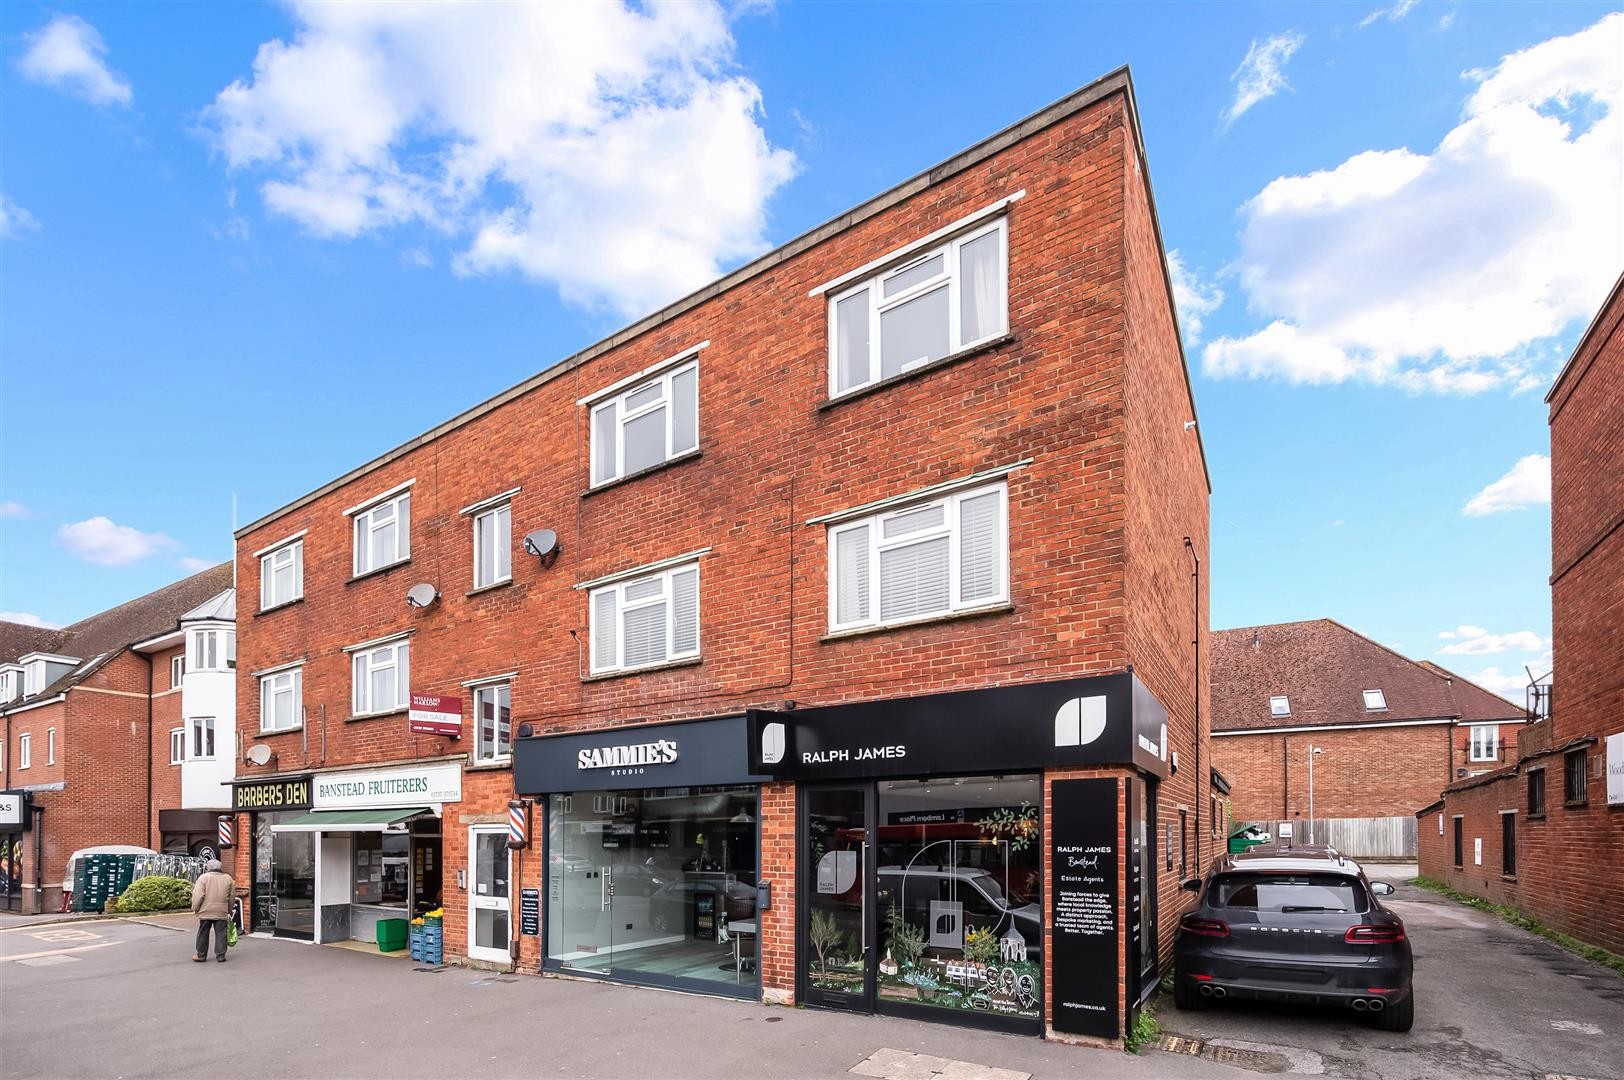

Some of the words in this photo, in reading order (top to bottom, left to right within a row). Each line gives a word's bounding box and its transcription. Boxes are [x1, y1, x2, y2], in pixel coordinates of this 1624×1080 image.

[578, 739, 678, 769] SAMMIE'S
[802, 750, 849, 764] RALPH
[854, 746, 906, 760] JAMES
[238, 784, 282, 807] BARBERS
[286, 782, 307, 804] DEN
[320, 782, 365, 798] BANSTEAD
[368, 777, 428, 795] FRUITERERS
[1083, 876, 1104, 884] Agents
[1062, 1002, 1106, 1012] ralphjames.co.uk
